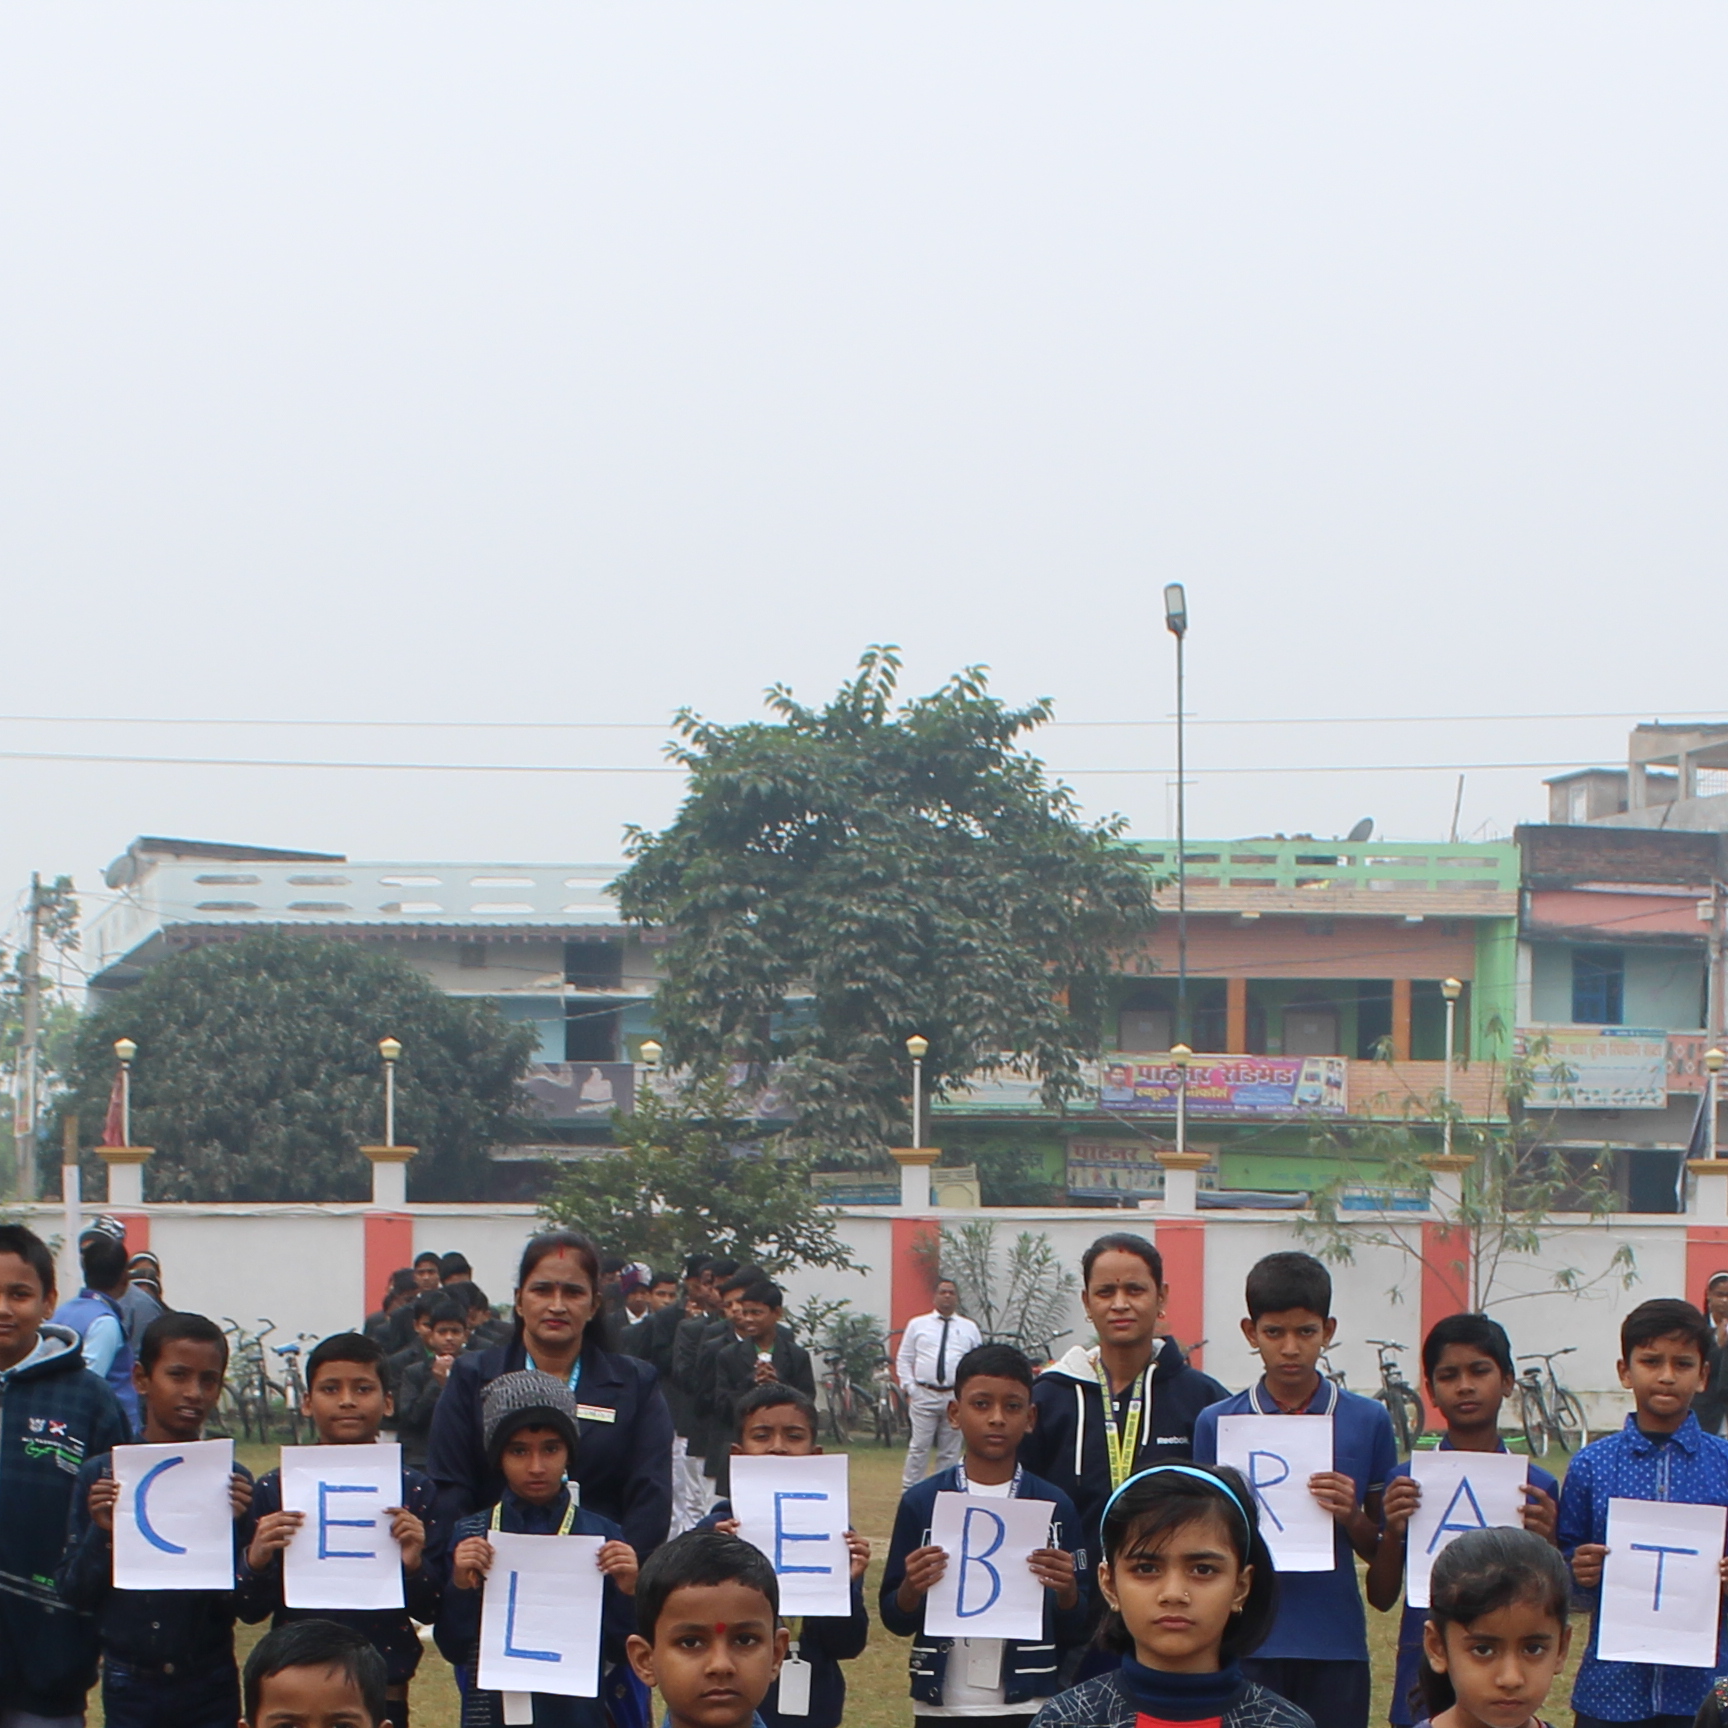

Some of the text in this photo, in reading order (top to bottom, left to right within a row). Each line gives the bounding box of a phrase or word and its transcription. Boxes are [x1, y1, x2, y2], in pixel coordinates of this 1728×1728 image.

[134, 1456, 188, 1555] C
[317, 1481, 378, 1560] E
[773, 1492, 833, 1574] E
[1247, 1450, 1289, 1534] R
[1426, 1476, 1488, 1555] A
[956, 1506, 1006, 1618] B
[1631, 1543, 1700, 1612] T
[503, 1571, 562, 1663] L
